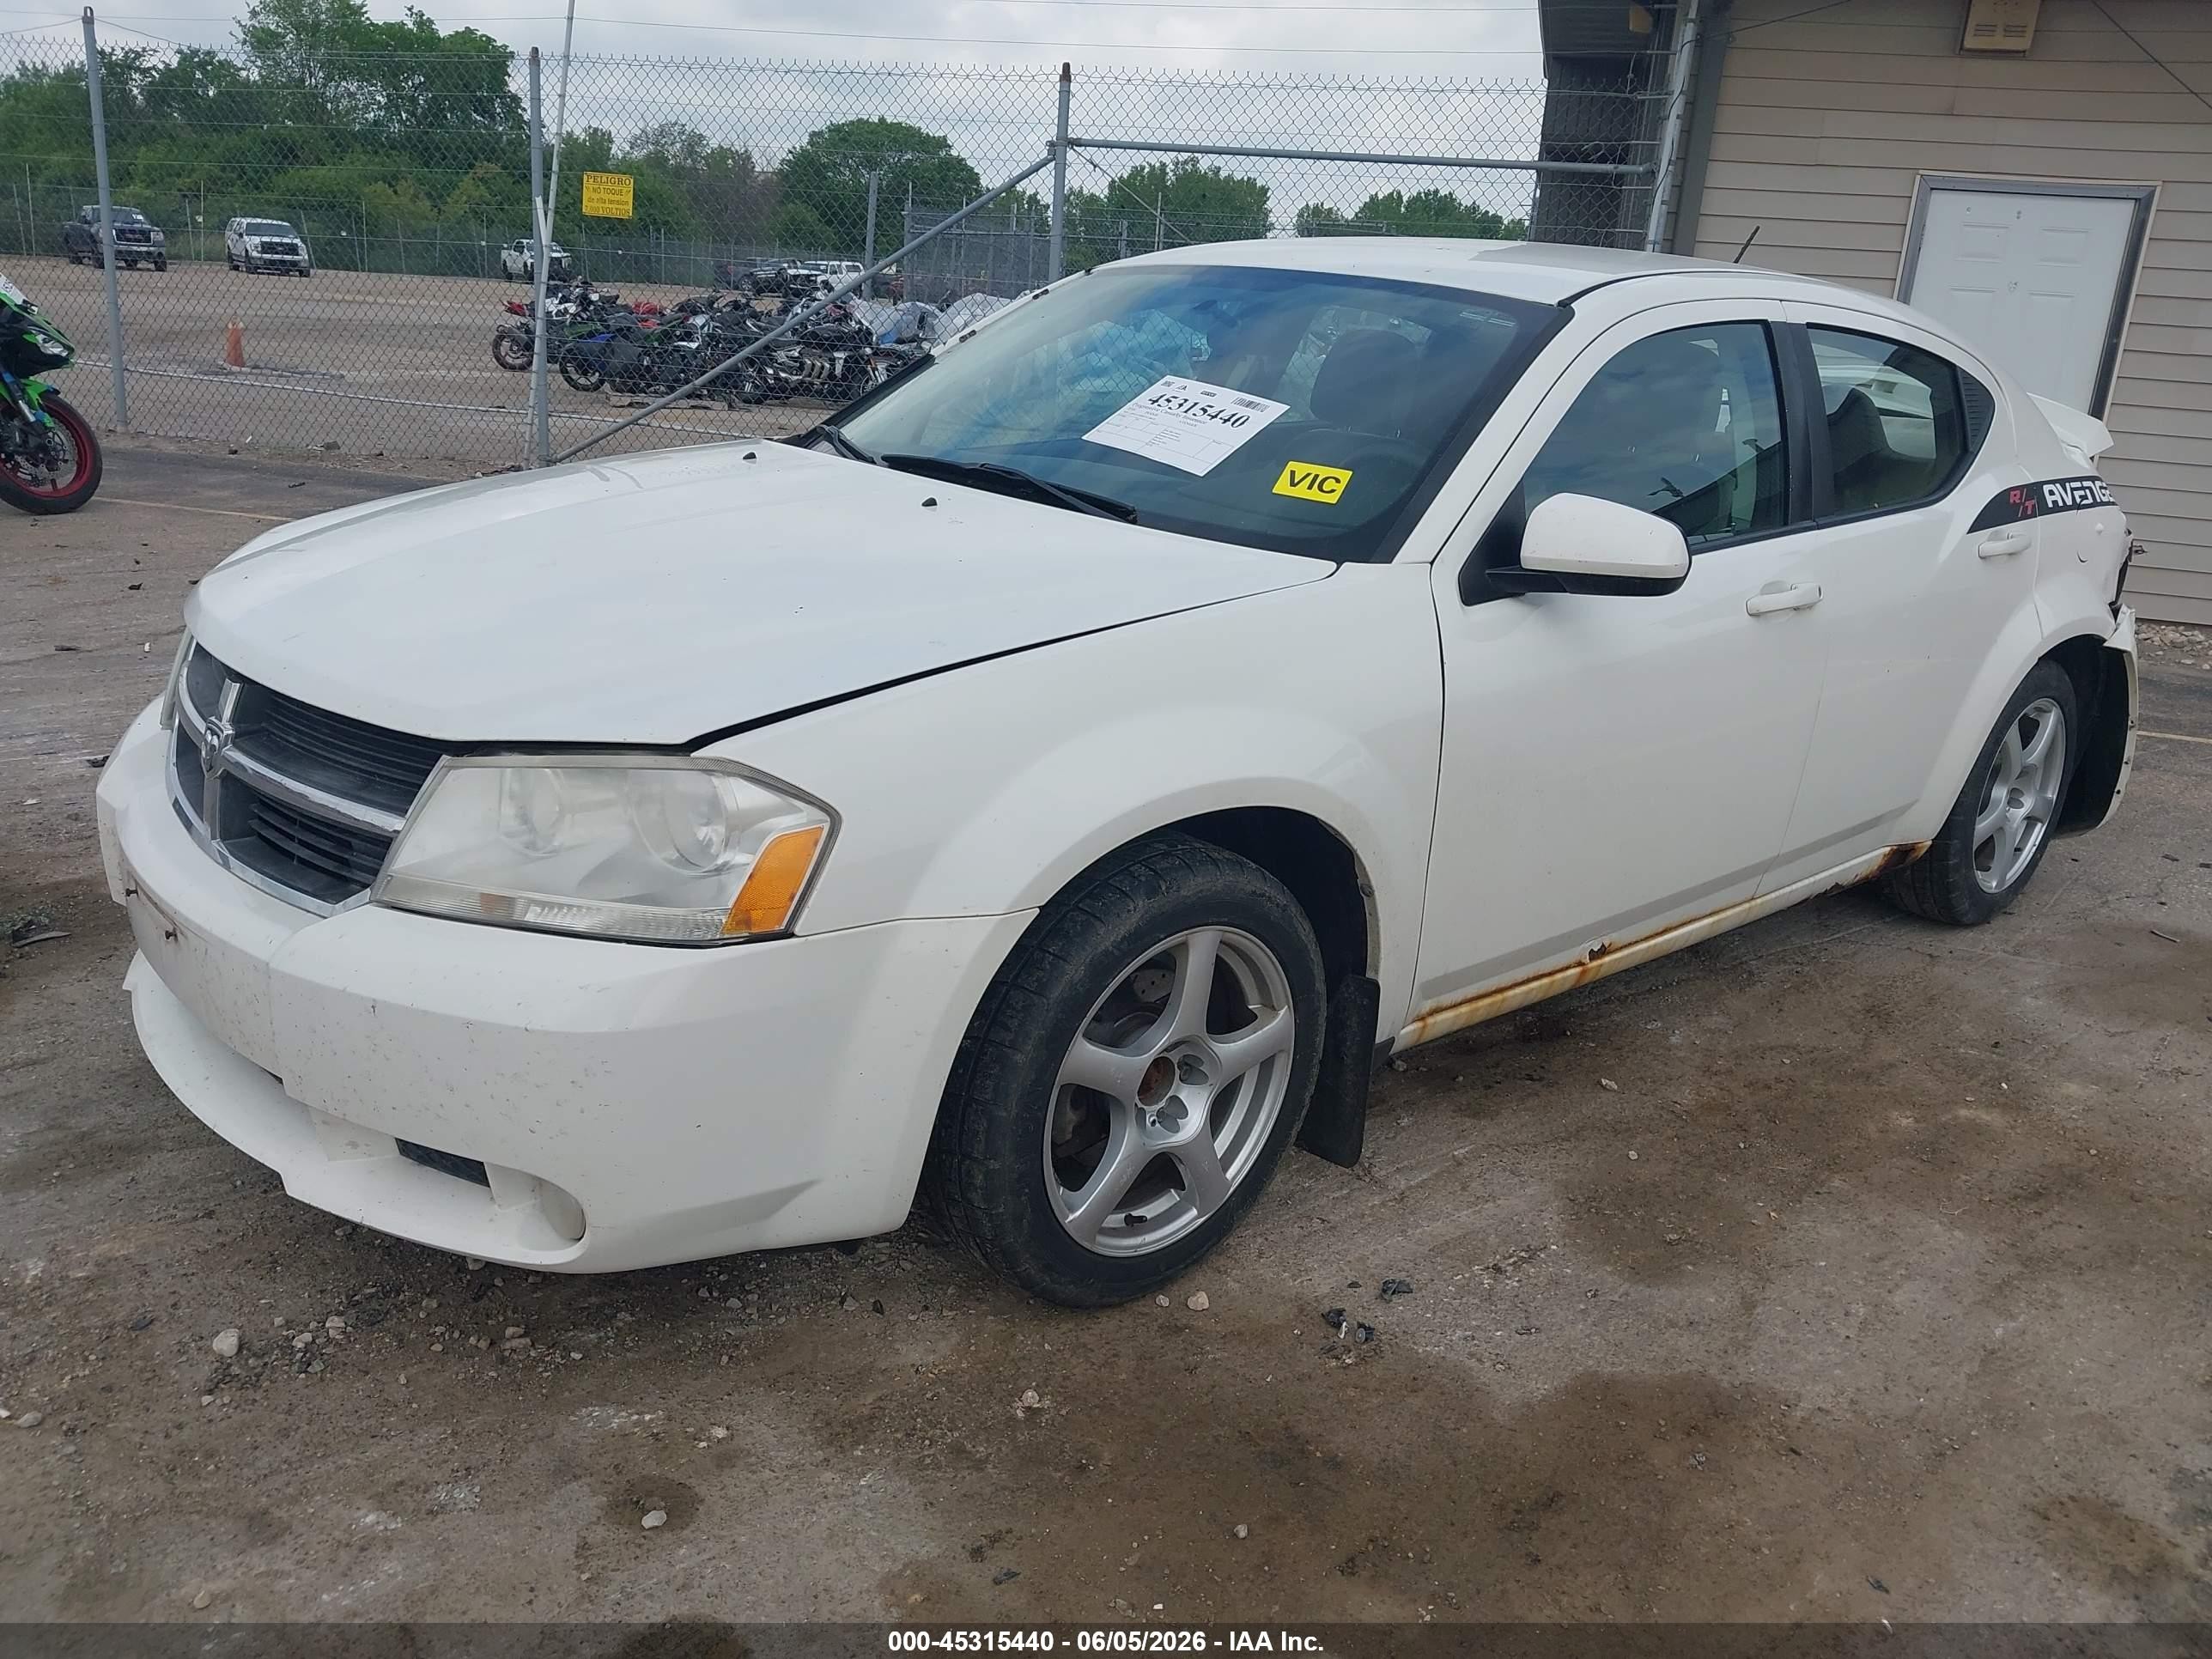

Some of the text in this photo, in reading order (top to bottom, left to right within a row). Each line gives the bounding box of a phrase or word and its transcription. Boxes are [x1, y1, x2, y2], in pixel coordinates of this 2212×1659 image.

[586, 174, 631, 185] PELIGRO
[603, 187, 624, 196] TOQUE
[601, 206, 630, 216] VOLTIOS
[1148, 393, 1250, 428] 45315440
[1288, 469, 1341, 495] VIC
